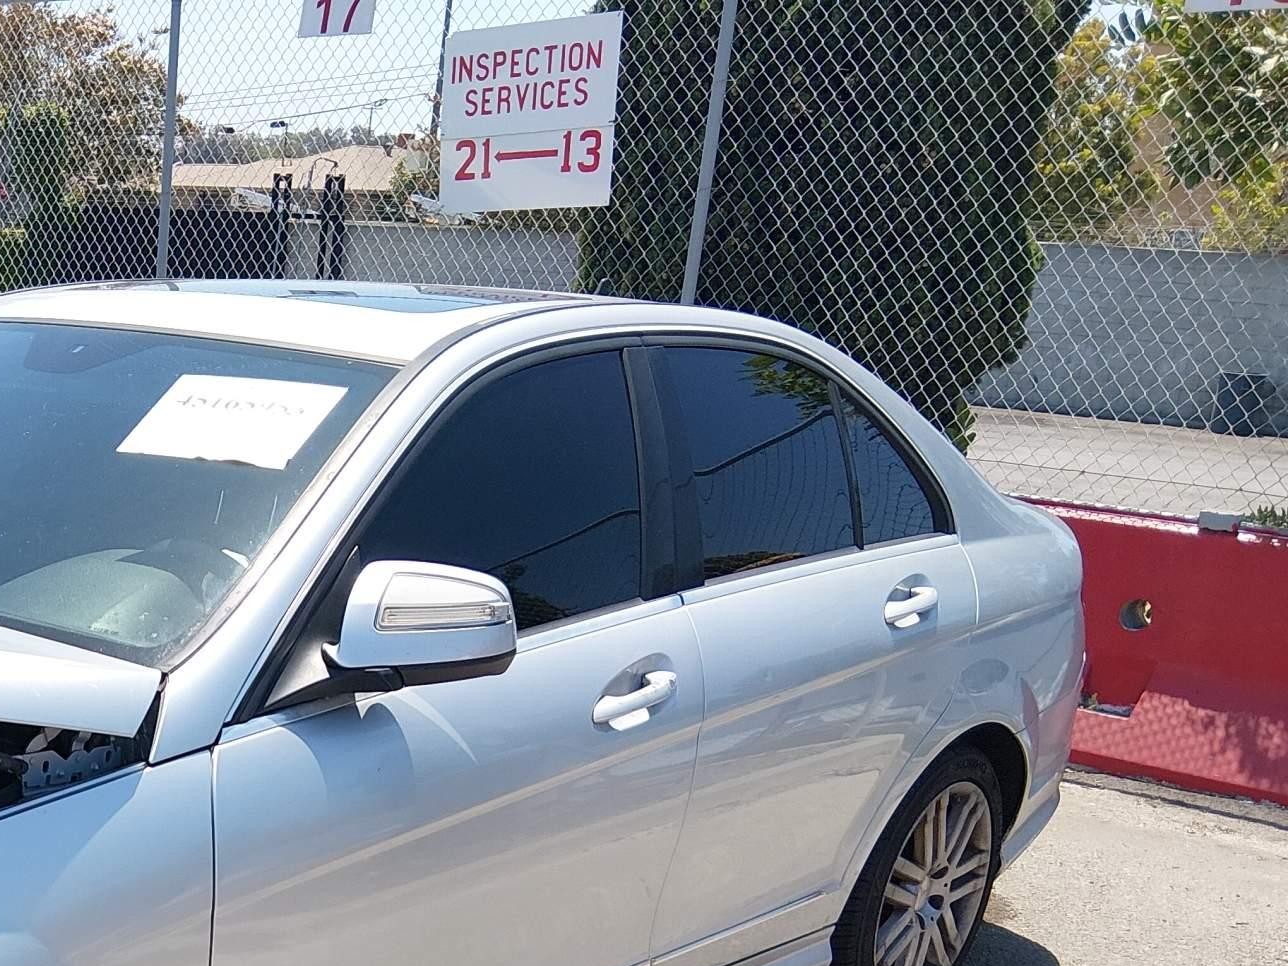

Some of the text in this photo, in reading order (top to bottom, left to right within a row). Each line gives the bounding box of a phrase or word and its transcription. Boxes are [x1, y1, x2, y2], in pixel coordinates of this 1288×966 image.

[316, 0, 360, 34] 17
[451, 40, 603, 84] INSPECTION
[464, 77, 589, 117] SERVICES
[454, 129, 602, 181] 21 13
